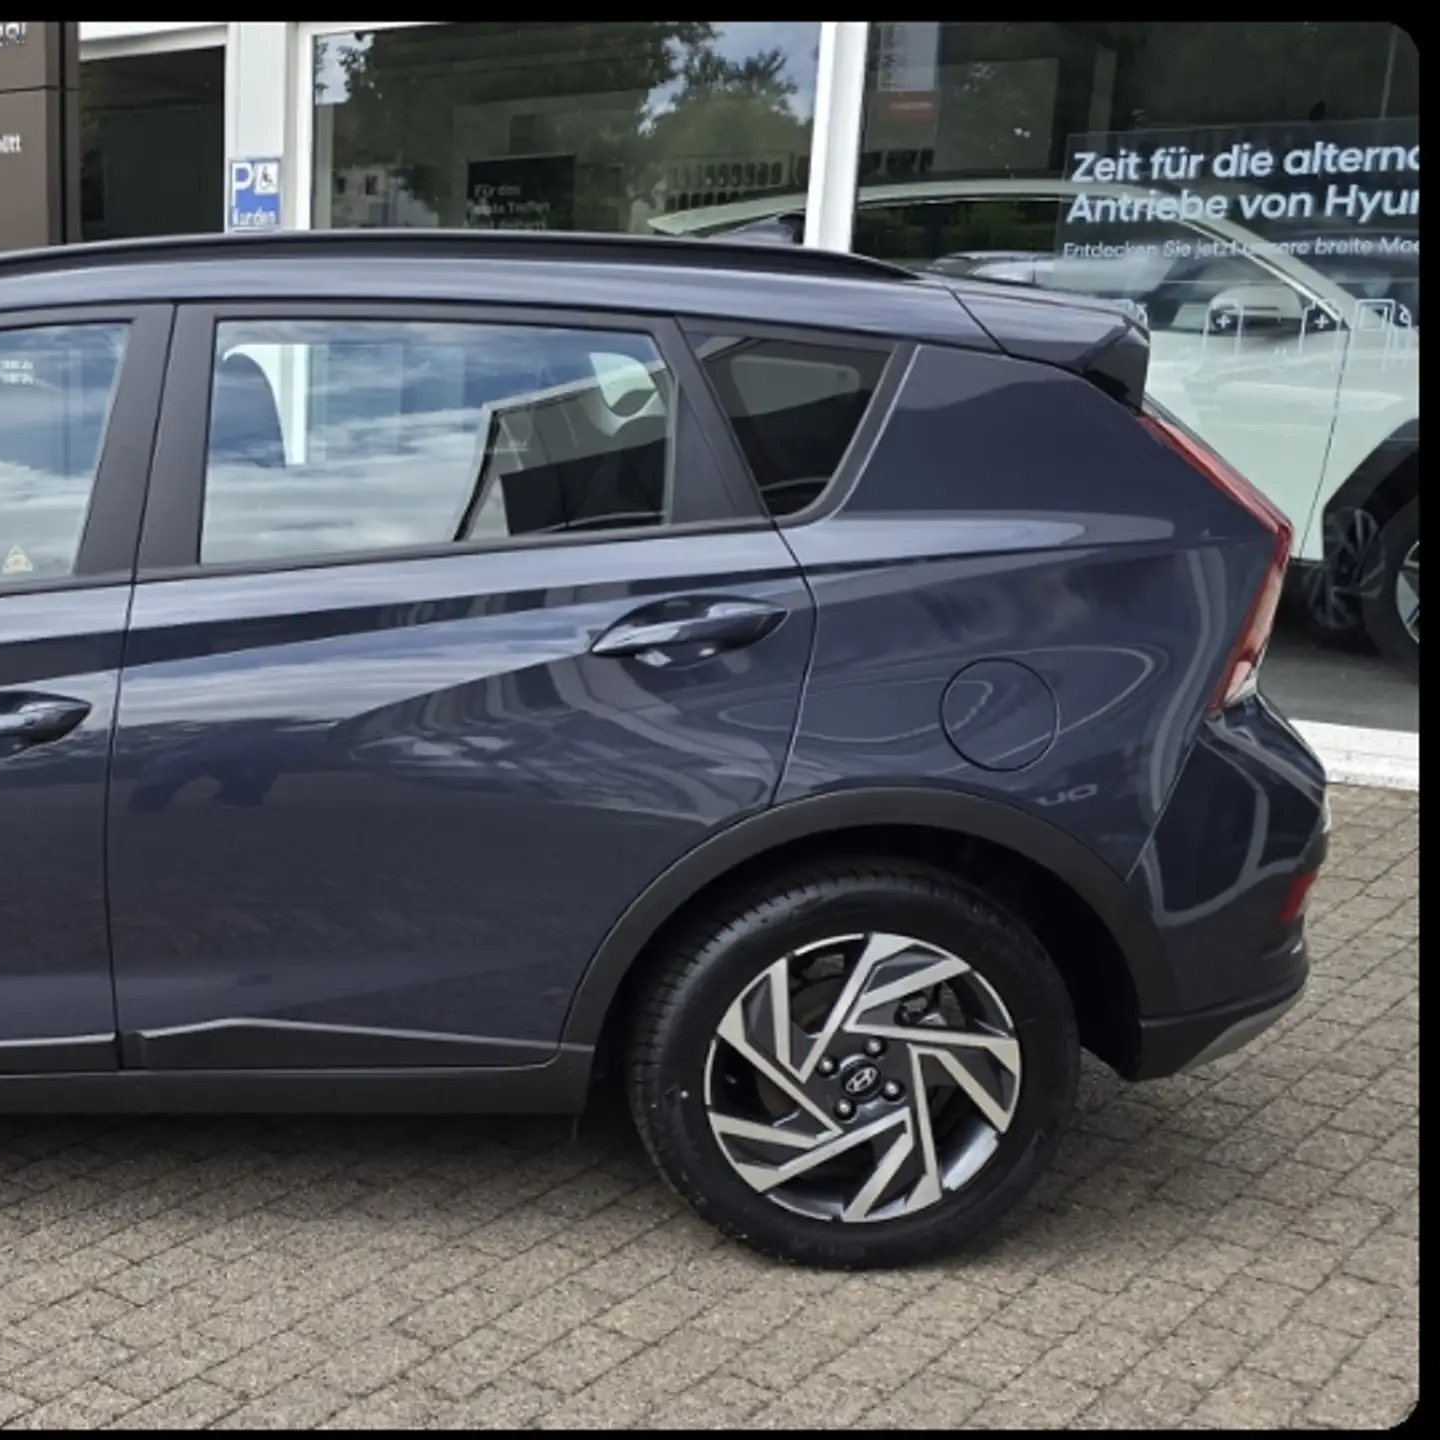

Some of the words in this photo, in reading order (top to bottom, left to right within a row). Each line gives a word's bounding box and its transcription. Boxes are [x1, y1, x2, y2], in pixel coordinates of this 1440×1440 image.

[1072, 150, 1141, 182] Zeit
[1150, 146, 1204, 180] für
[1212, 142, 1273, 178] die
[232, 162, 253, 207] P
[1066, 188, 1228, 223] Antriebe
[1240, 193, 1313, 220] von
[1063, 240, 1159, 259] Entdecken
[1162, 239, 1192, 258] Sie
[1314, 236, 1373, 255] breite
